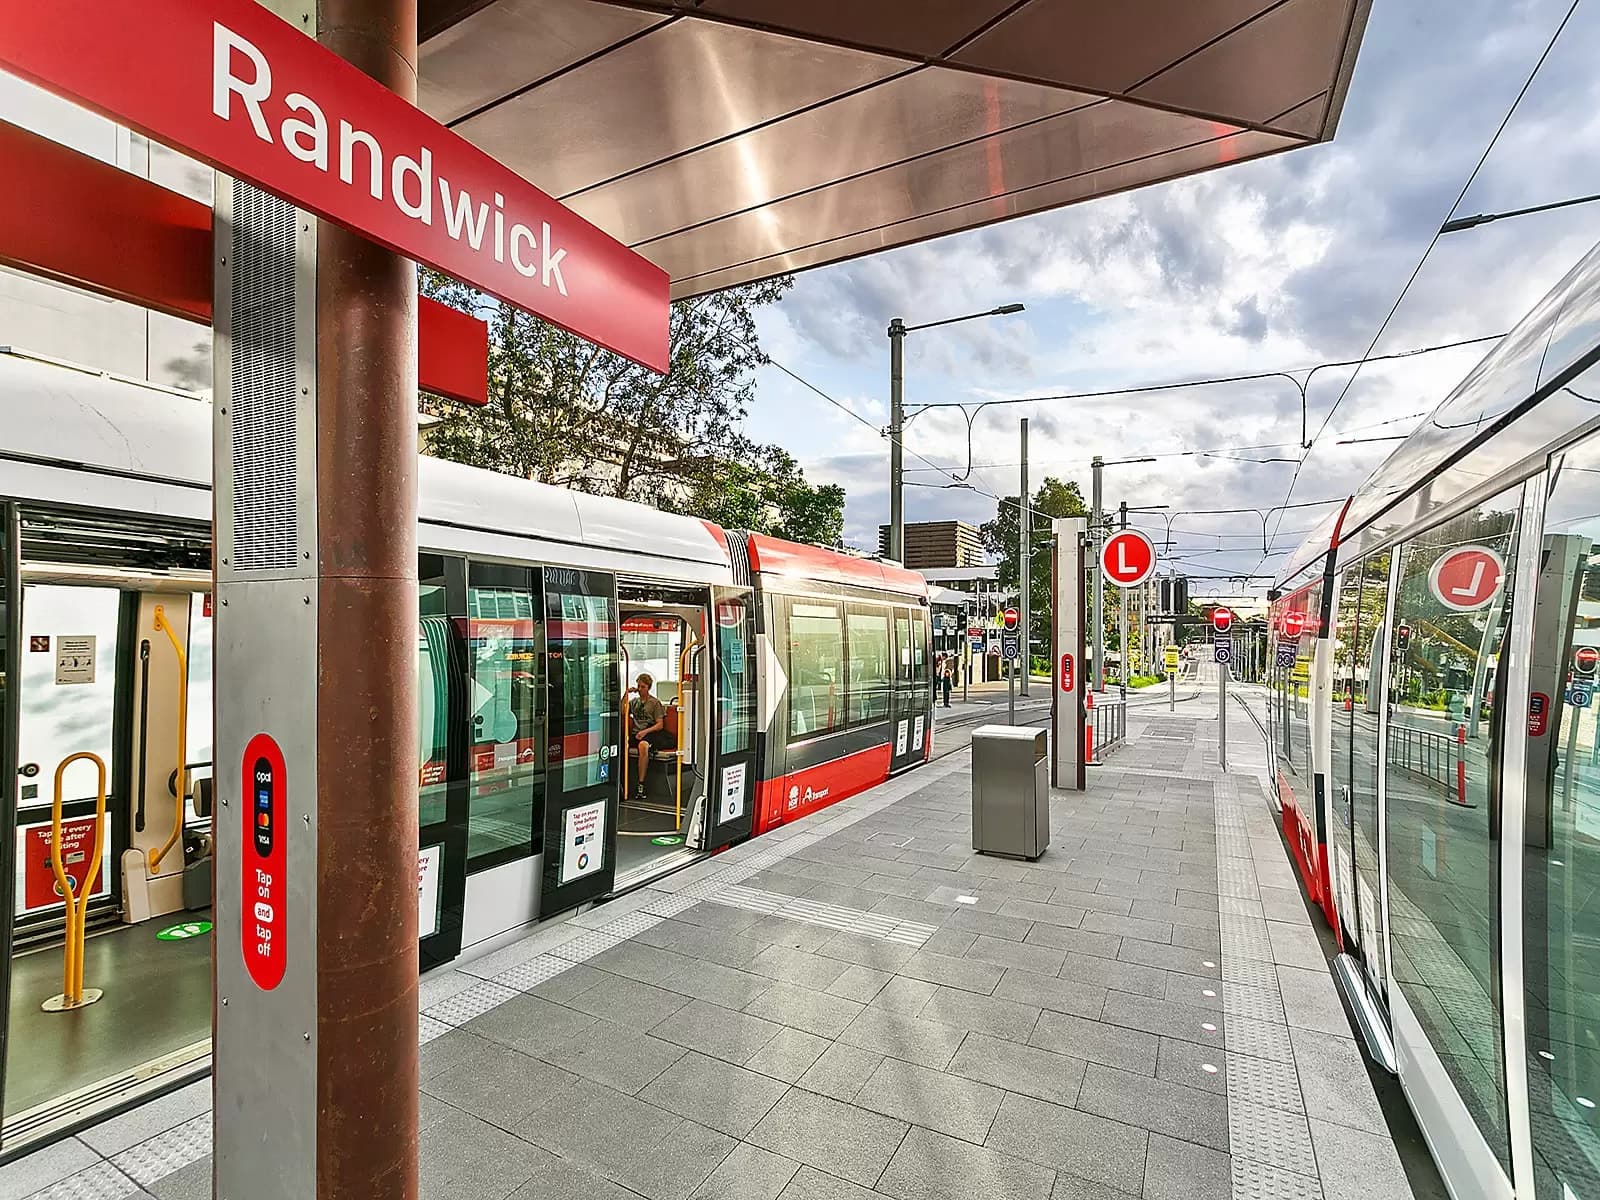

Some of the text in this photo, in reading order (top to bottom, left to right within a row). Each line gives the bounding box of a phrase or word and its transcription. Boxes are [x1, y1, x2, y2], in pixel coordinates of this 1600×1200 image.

[213, 20, 568, 296] Randwick
[1118, 542, 1138, 574] L
[1219, 651, 1226, 659] 15
[68, 824, 92, 832] every
[65, 833, 86, 841] after
[256, 869, 272, 887] Tap
[258, 886, 270, 899] on
[257, 907, 270, 919] and
[256, 923, 272, 941] tap
[257, 943, 271, 957] off
